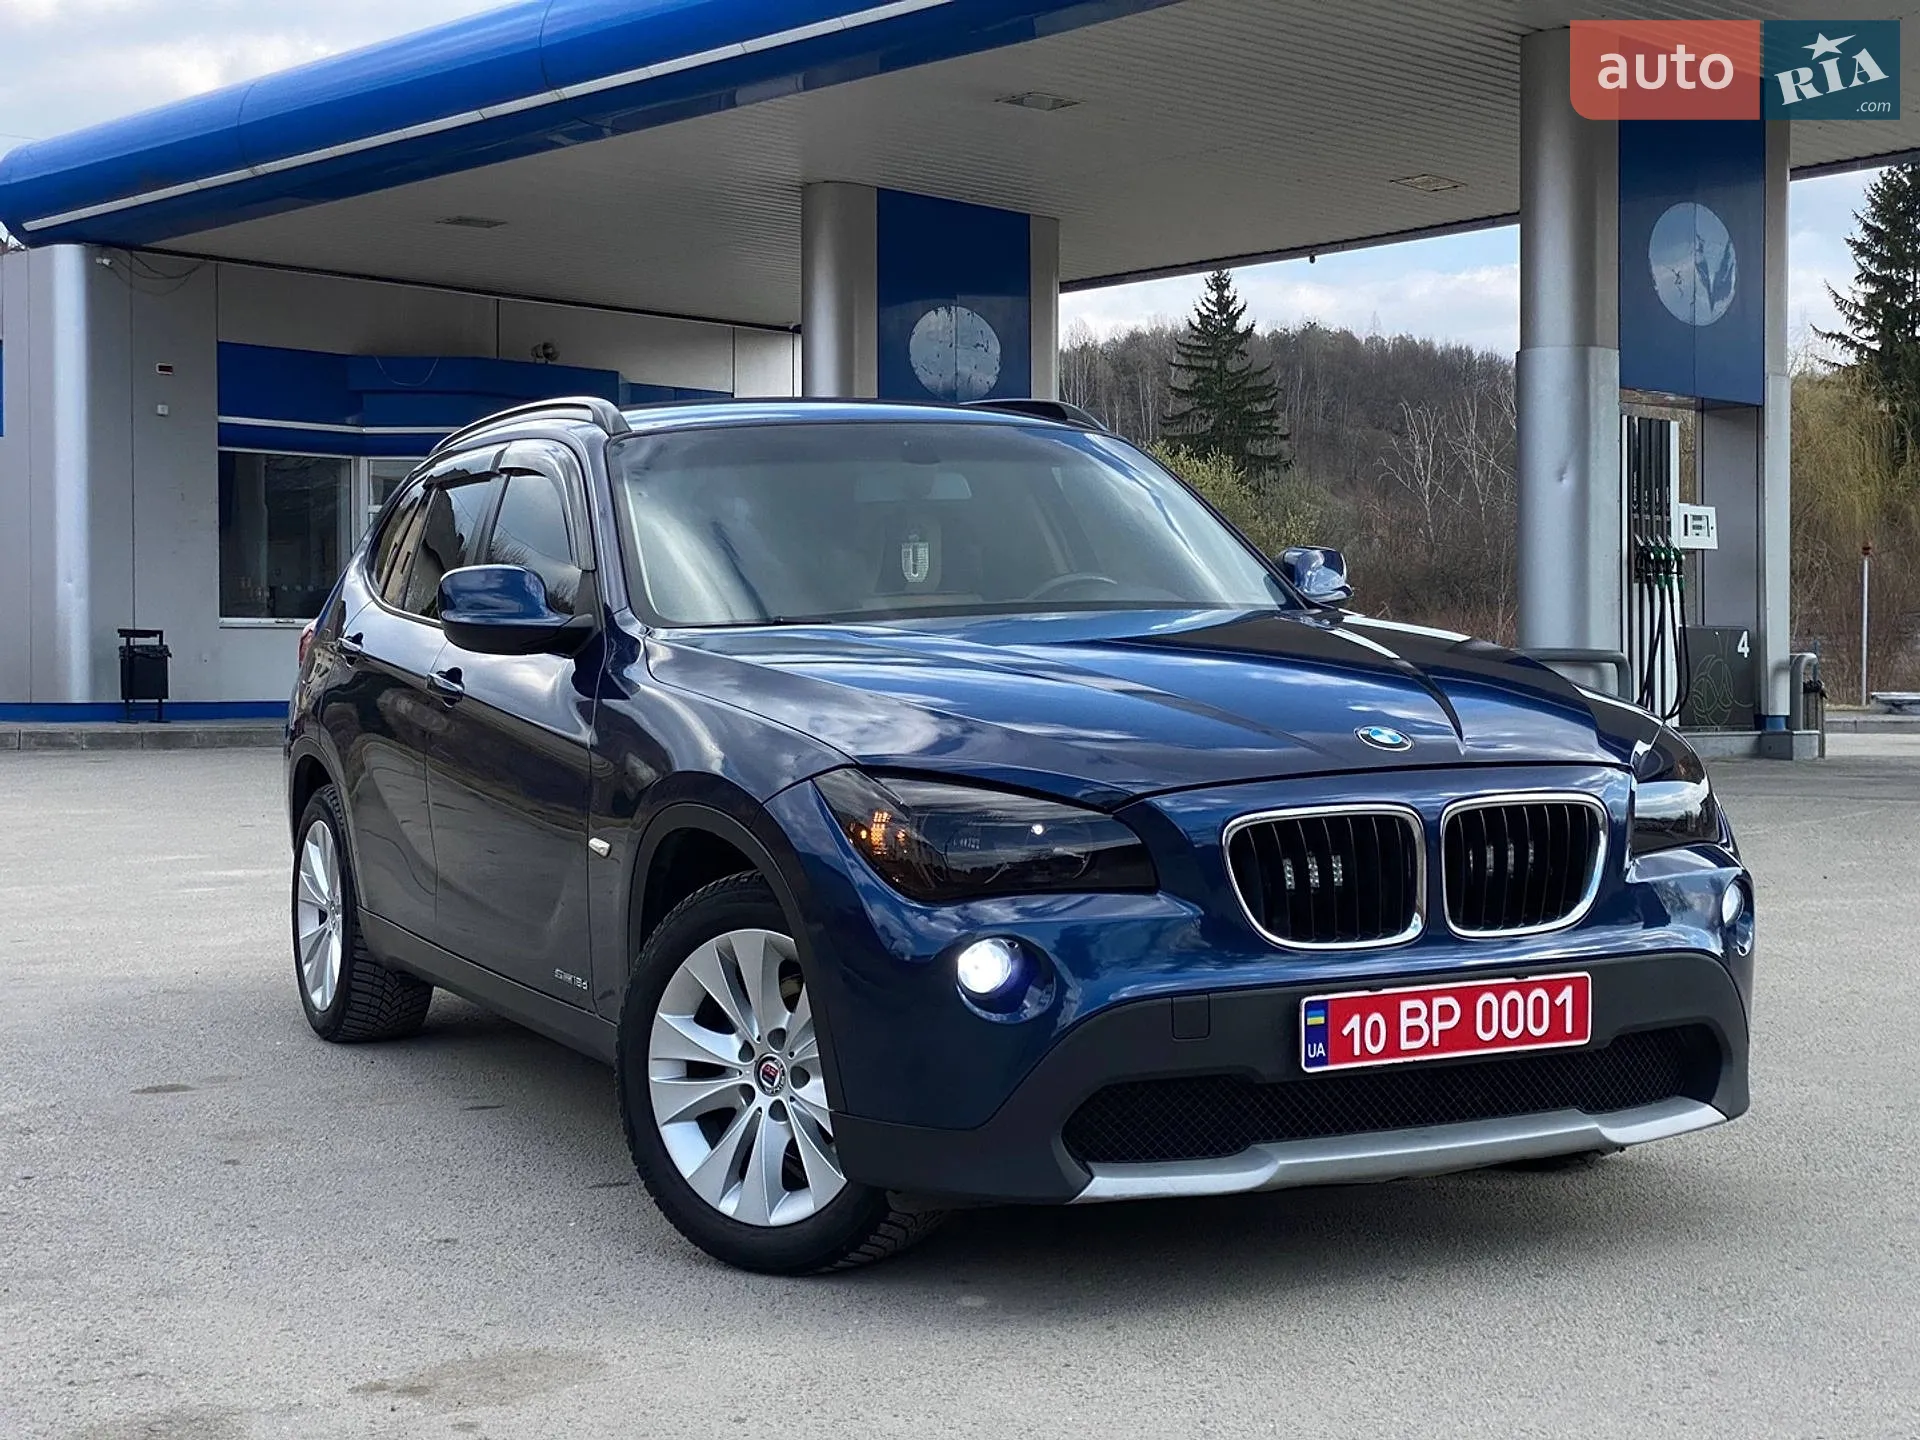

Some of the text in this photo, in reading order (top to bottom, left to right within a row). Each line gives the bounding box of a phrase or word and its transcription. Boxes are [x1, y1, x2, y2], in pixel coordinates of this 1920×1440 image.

[1737, 630, 1750, 658] 4
[1341, 984, 1573, 1057] 10 BP 0001
[1307, 1042, 1326, 1058] UA
